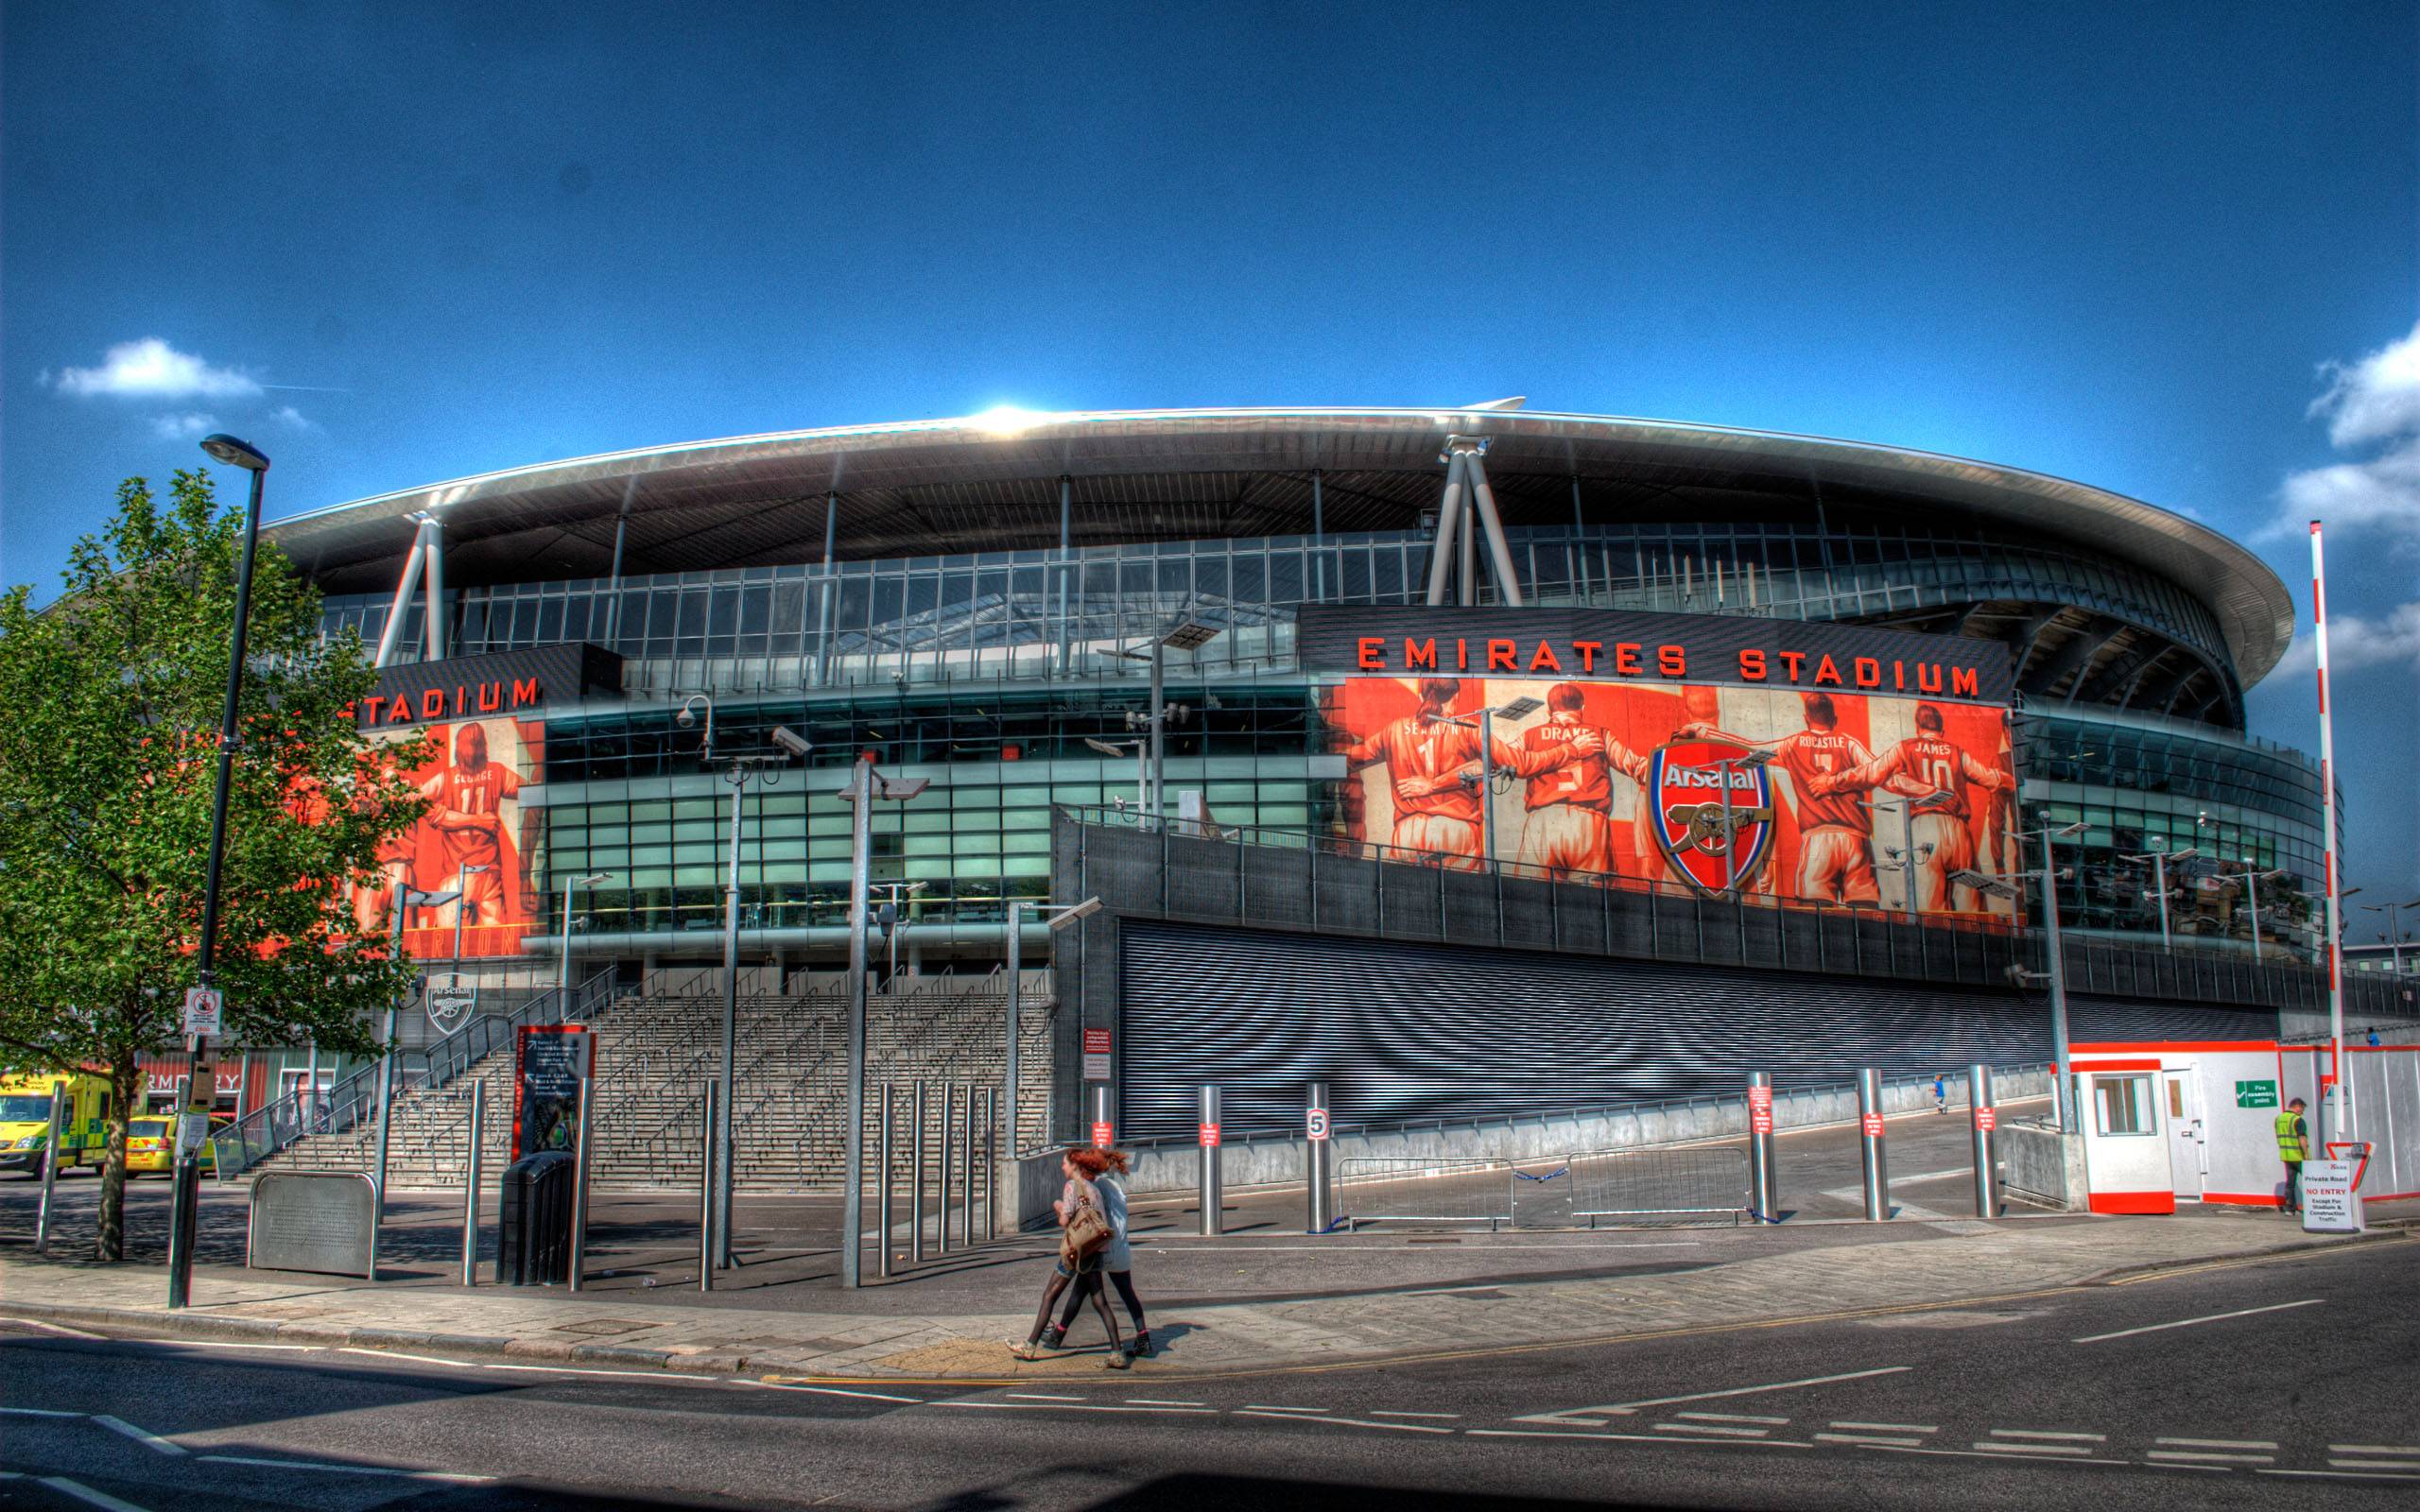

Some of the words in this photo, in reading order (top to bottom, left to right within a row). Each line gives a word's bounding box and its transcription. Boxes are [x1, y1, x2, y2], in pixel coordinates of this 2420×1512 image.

[1358, 637, 1685, 676] EMIRATES
[1739, 649, 1979, 696] STADIUM
[1799, 735, 1846, 748] ROCASTLE
[1915, 742, 1951, 755] JAMES
[1418, 738, 1434, 778] 1
[433, 986, 471, 995] Arsenal
[1311, 1116, 1322, 1132] 5
